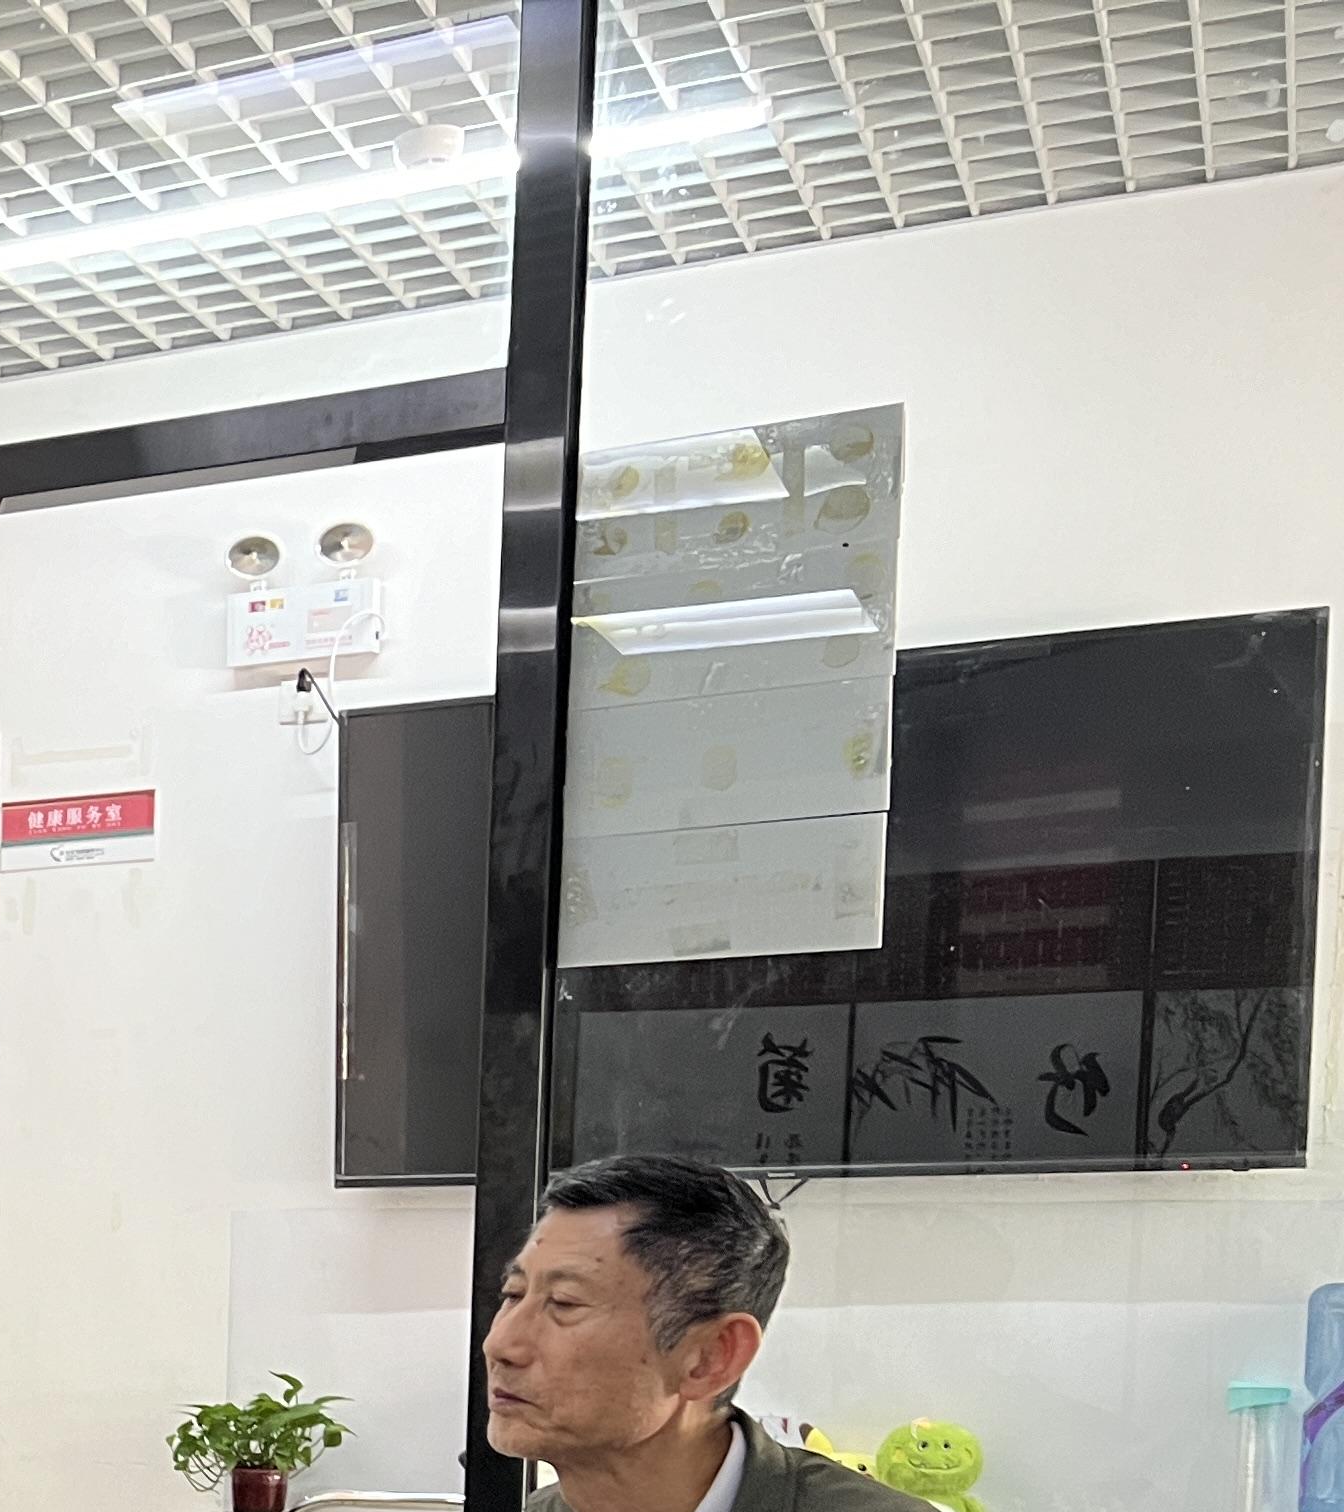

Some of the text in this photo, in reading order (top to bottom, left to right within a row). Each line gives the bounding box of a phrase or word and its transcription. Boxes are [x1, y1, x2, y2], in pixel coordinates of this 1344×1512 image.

[28, 803, 122, 830] 健康服务室
